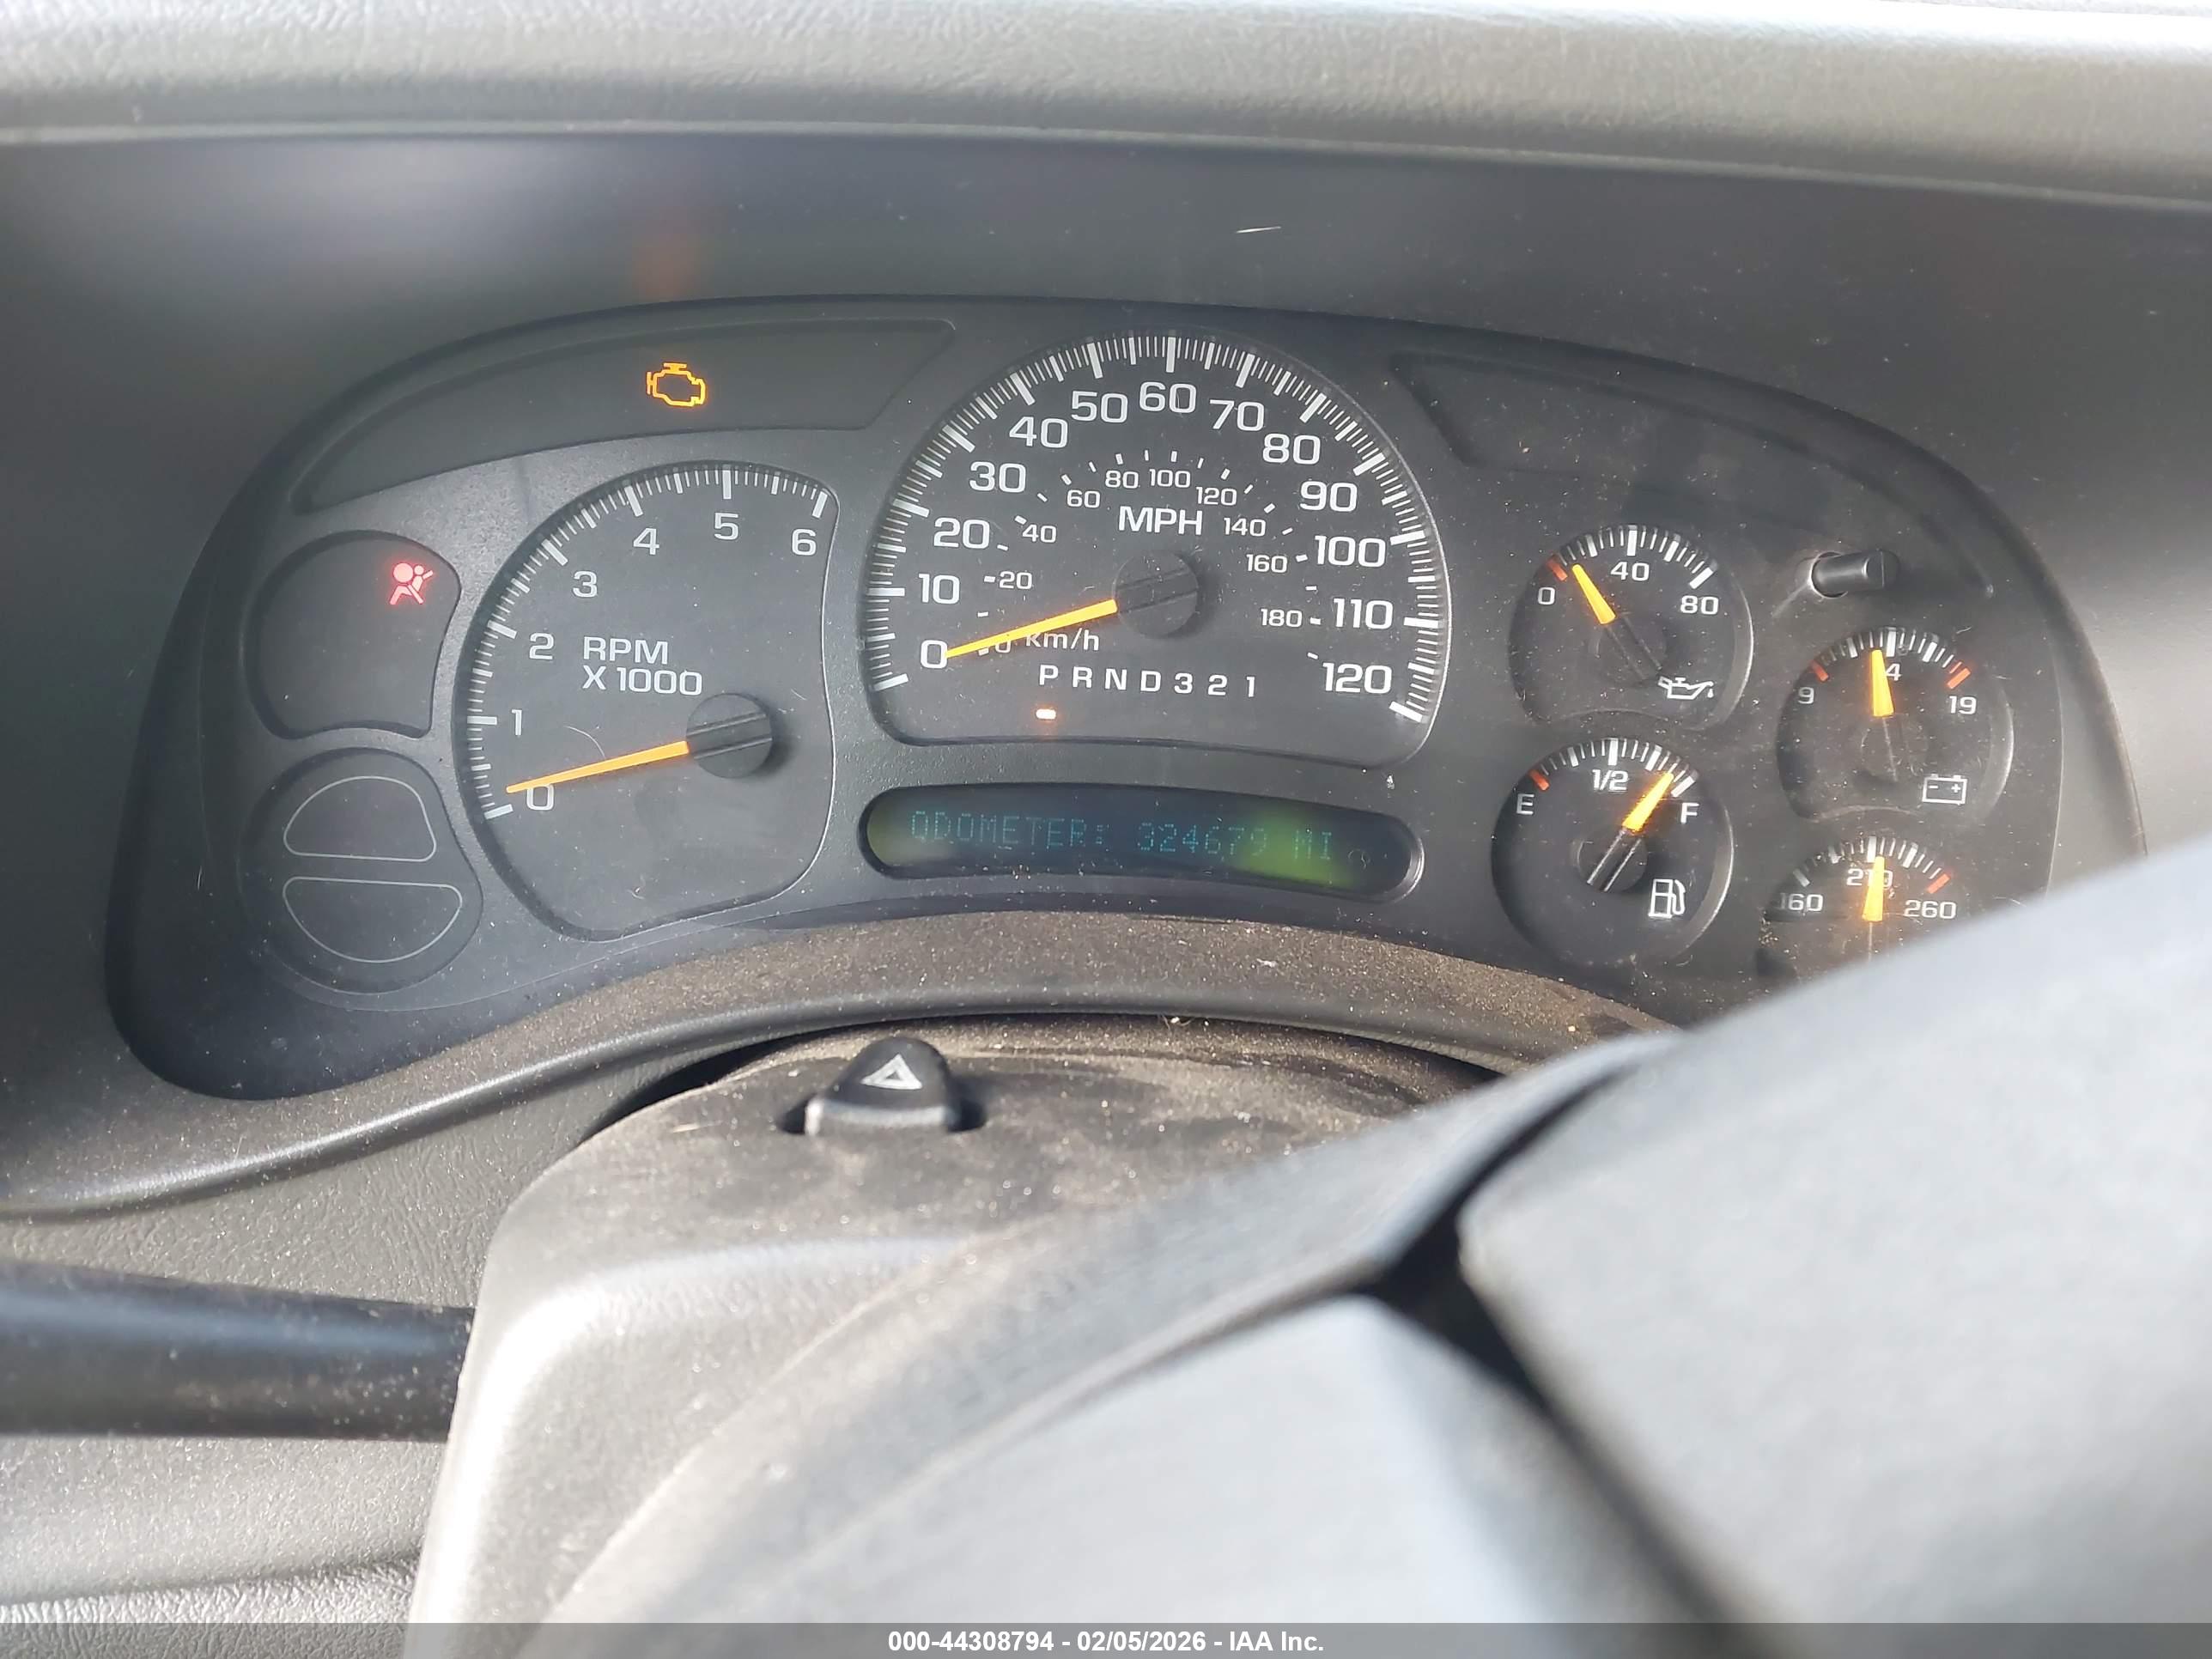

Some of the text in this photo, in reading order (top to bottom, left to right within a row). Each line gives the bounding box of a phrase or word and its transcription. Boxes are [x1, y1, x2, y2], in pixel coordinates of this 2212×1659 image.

[1071, 390, 1128, 423] 50
[1139, 381, 1197, 414] 60
[1209, 399, 1265, 431] 70
[1009, 416, 1068, 448] 40
[1262, 433, 1321, 465] 80
[969, 461, 1026, 493] 30
[1104, 470, 1139, 489] 80
[1149, 468, 1191, 489] 100
[1066, 489, 1101, 508] 60
[1195, 486, 1237, 506] 120
[1299, 481, 1358, 512] 90
[714, 512, 738, 540] 5
[933, 517, 990, 549] 20
[1022, 524, 1057, 543] 40
[1118, 506, 1203, 536] MPH
[1224, 517, 1267, 537] 140
[633, 527, 660, 556] 4
[792, 528, 817, 556] 6
[1315, 535, 1386, 568] 100
[1246, 554, 1288, 574] 160
[1610, 561, 1650, 581] 40
[573, 570, 598, 598] 3
[918, 573, 960, 605] 10
[999, 570, 1032, 590] 20
[1537, 586, 1556, 605] 0
[1680, 595, 1719, 615] 80
[1261, 608, 1303, 628] 180
[1333, 598, 1394, 630] 110
[529, 632, 555, 660] 2
[583, 636, 668, 665] RPM
[920, 639, 947, 669] 0
[1322, 662, 1393, 694] 120
[1798, 686, 1814, 705] 9
[1949, 696, 1977, 715] 19
[511, 708, 522, 736] 1
[1592, 769, 1629, 793] 1/2
[526, 784, 555, 811] 0
[1516, 793, 1534, 815] E
[1680, 802, 1699, 824] F
[1137, 822, 1267, 856] 324679
[1294, 830, 1332, 860] MI
[1780, 892, 1824, 912] 160
[1904, 899, 1957, 920] 260
